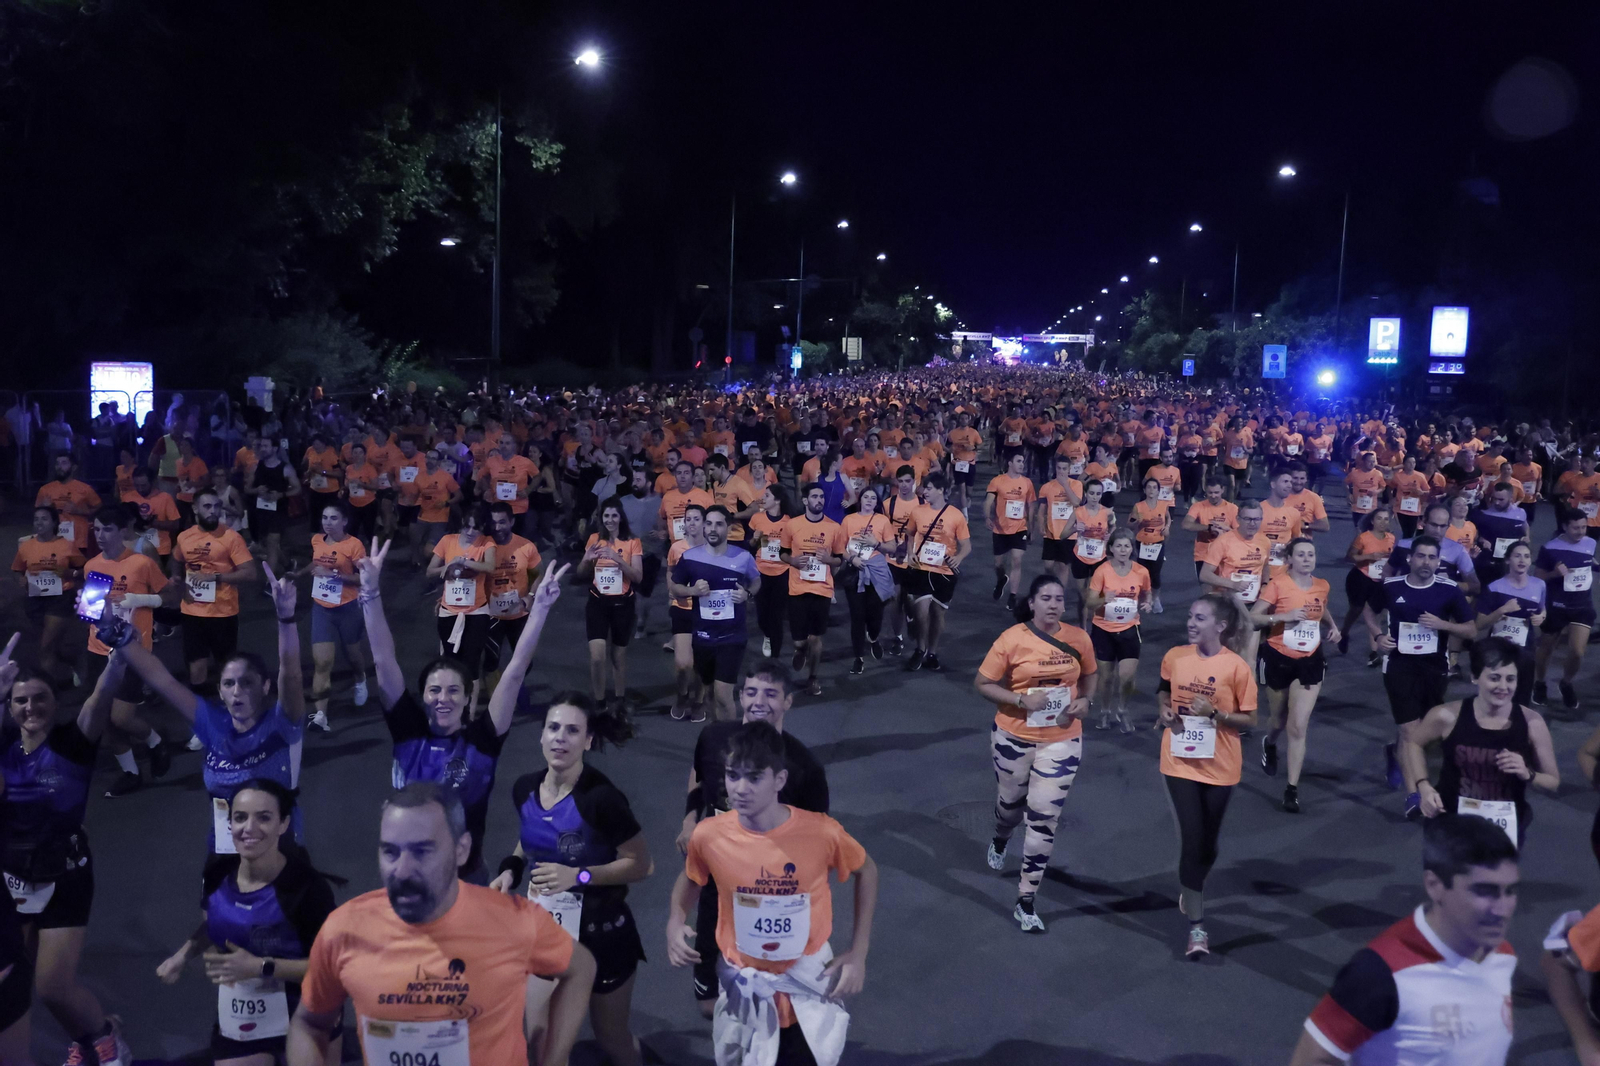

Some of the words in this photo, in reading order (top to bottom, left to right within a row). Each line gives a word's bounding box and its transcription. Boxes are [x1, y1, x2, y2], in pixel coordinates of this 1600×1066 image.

[708, 599, 726, 608] 3505
[1293, 629, 1315, 639] 11316
[1407, 633, 1431, 642] 11319
[754, 878, 799, 887] NOCTURNA
[736, 886, 775, 894] SEVILLA
[775, 887, 797, 895] KH7
[754, 917, 792, 934] 4358
[406, 981, 470, 993] NOCTURNA
[378, 993, 432, 1005] SEVILLA
[434, 993, 467, 1006] KH7
[231, 998, 266, 1015] 6793
[389, 1051, 441, 1066] 9094
